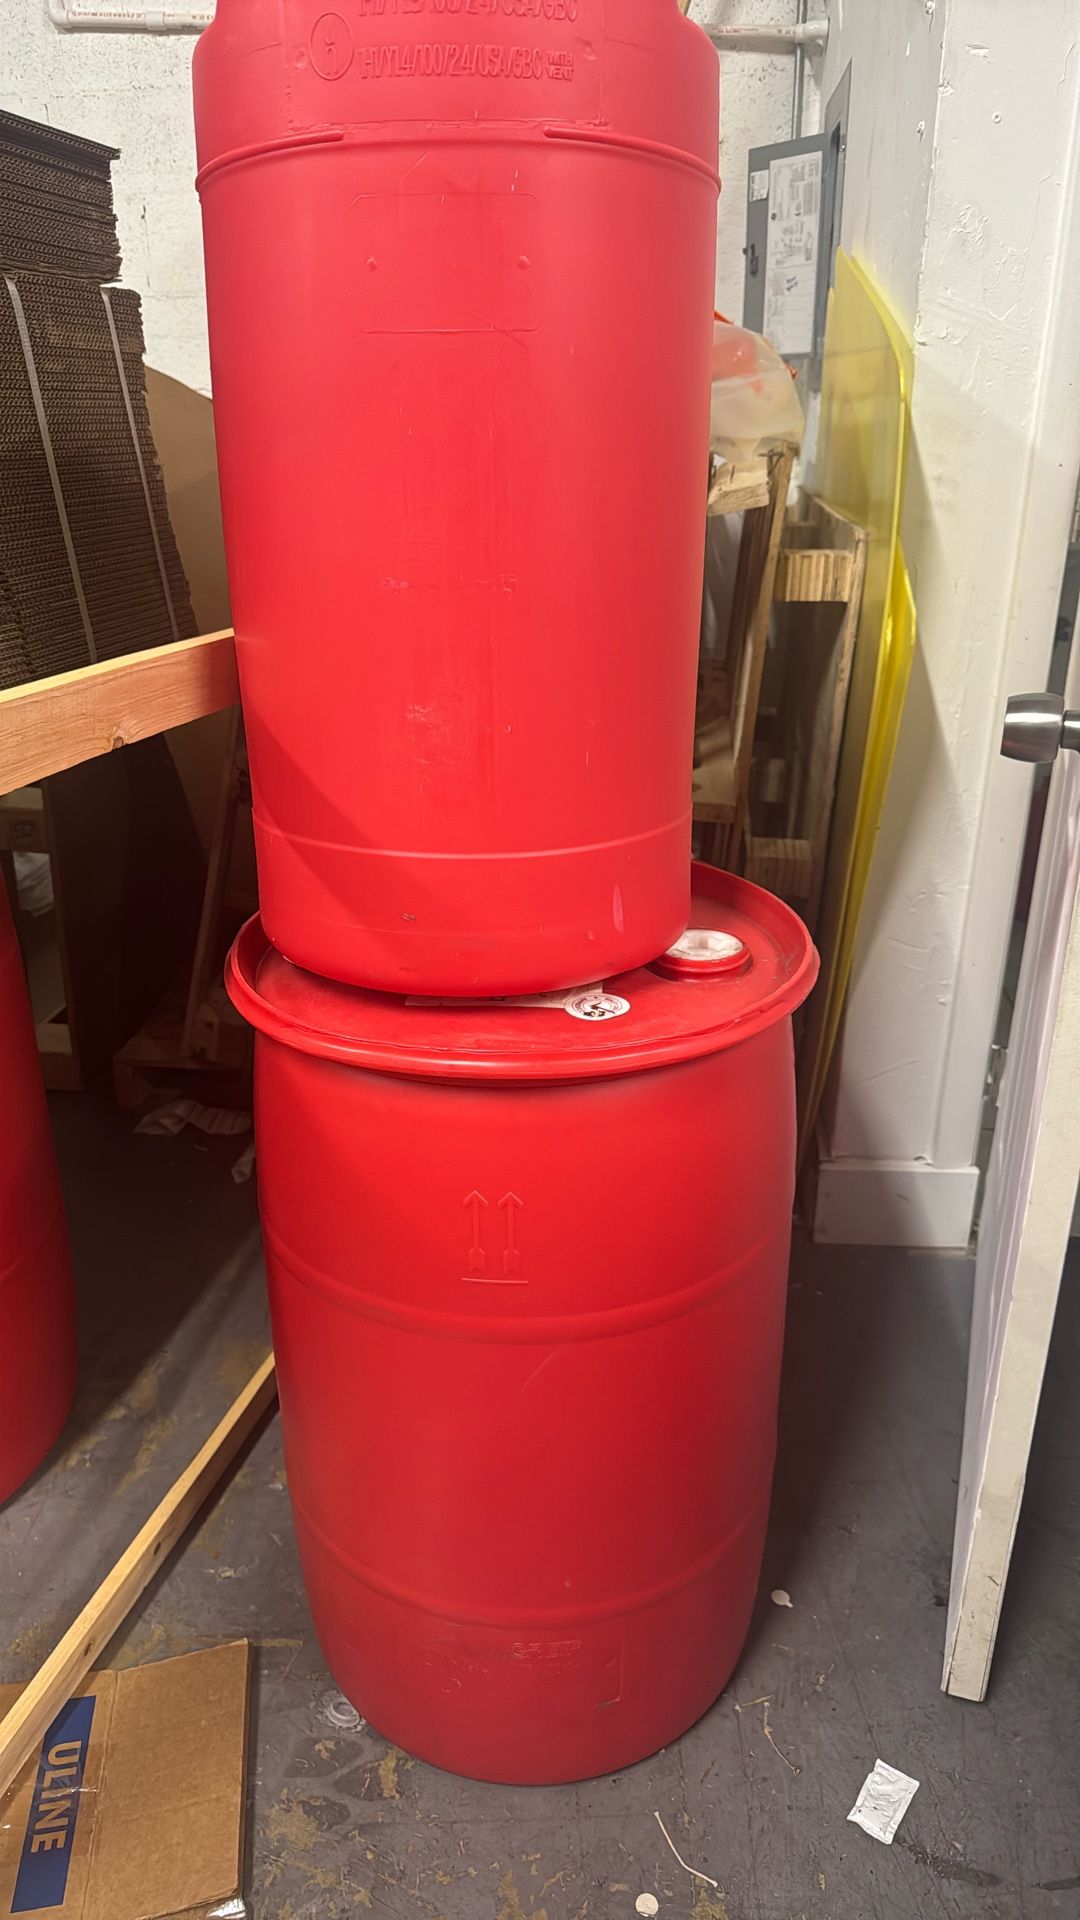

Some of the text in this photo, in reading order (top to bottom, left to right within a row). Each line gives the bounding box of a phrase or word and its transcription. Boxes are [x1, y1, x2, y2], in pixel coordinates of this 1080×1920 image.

[546, 51, 573, 66] WITH
[546, 65, 575, 82] VENT
[31, 1740, 82, 1854] ULINE
